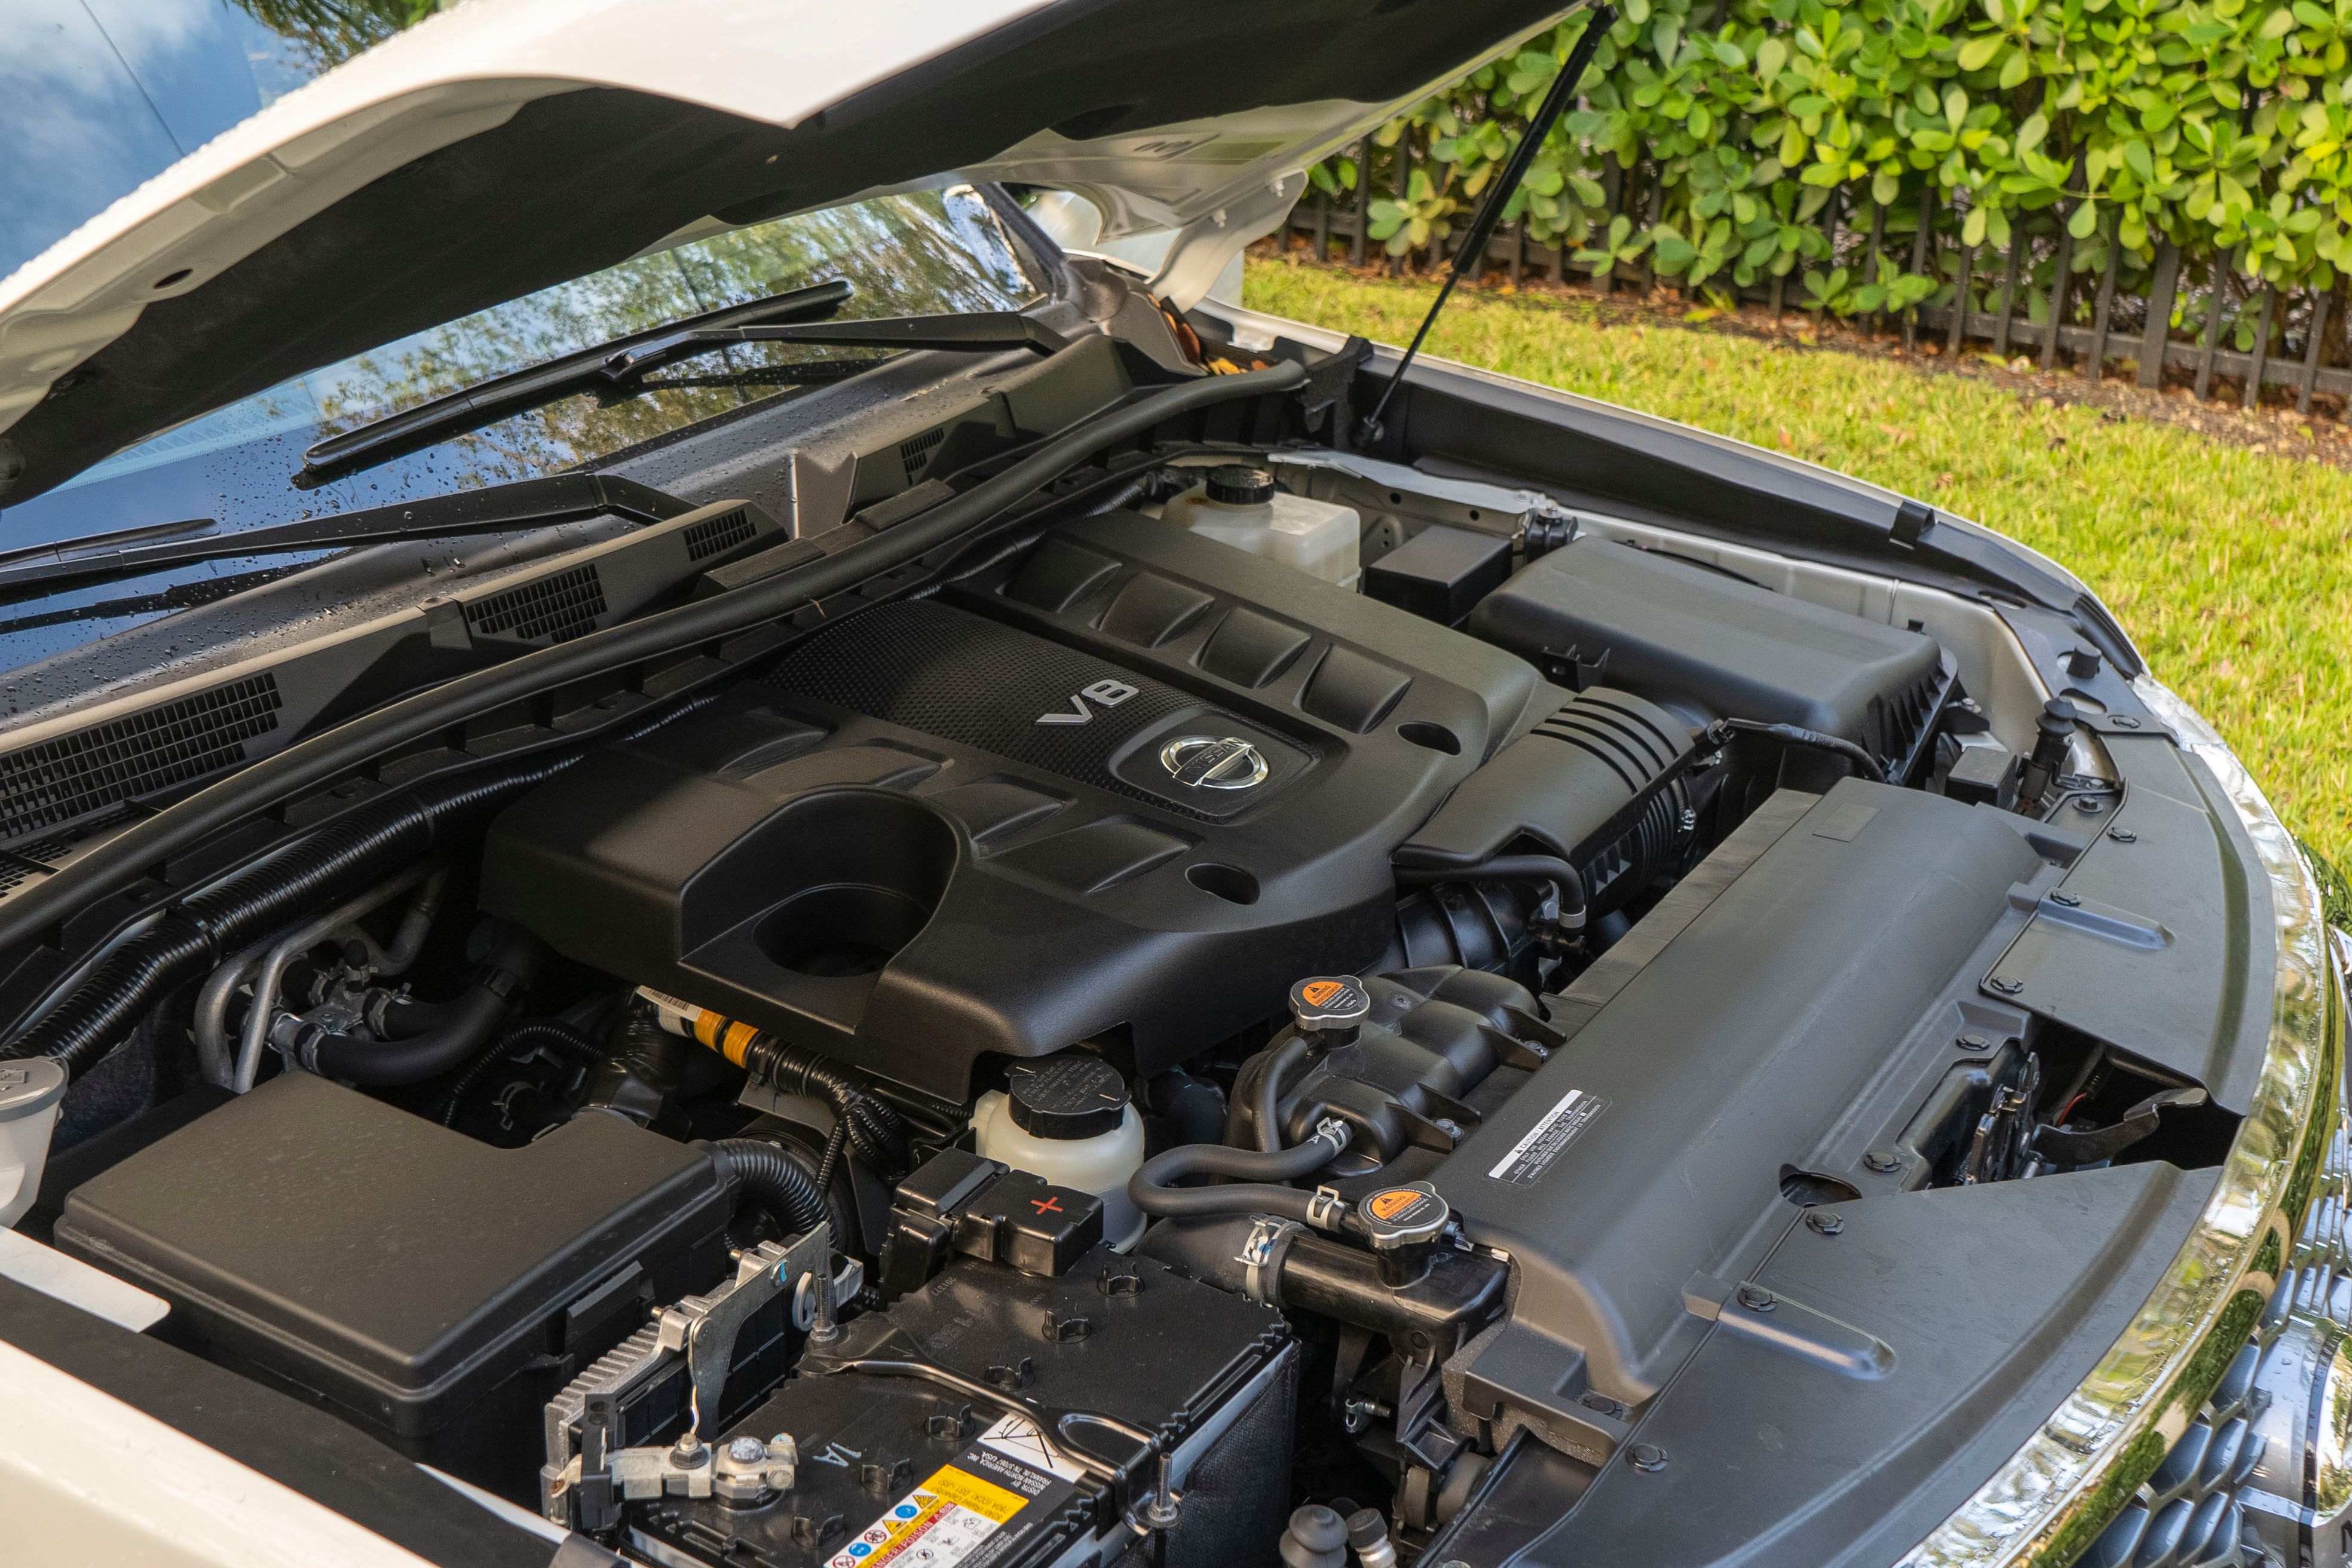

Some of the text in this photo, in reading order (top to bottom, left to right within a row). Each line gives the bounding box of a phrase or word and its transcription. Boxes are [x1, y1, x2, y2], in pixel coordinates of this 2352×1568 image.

[1035, 679, 1140, 726] V8
[1184, 737, 1245, 777] NISSAN
[1520, 1132, 1539, 1149] CAUTION
[1538, 1111, 1560, 1130] ATTENTION
[1380, 1195, 1406, 1212] WARNING
[1004, 1469, 1025, 1481] NORTH
[1023, 1477, 1046, 1490] NISSAN
[869, 1518, 933, 1568] ANGER/POISON
